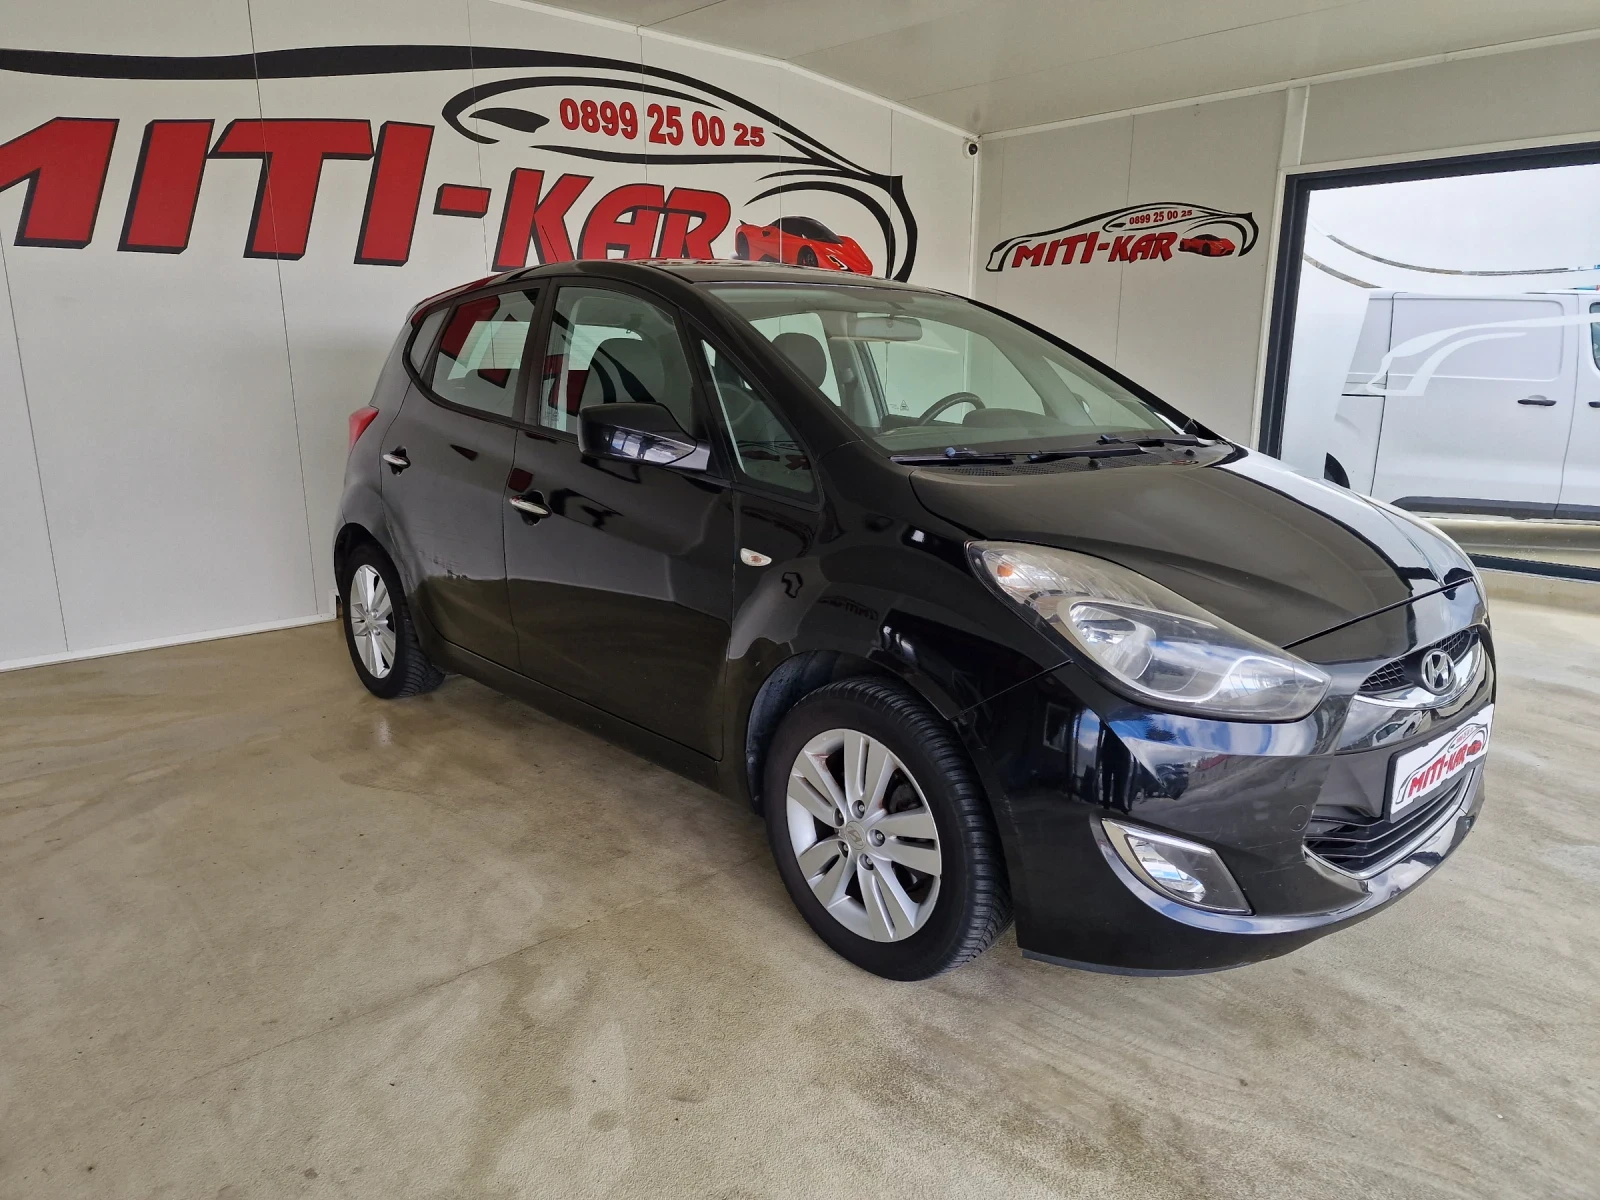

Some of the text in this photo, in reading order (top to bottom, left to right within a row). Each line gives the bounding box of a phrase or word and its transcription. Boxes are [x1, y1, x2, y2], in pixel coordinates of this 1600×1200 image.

[559, 98, 766, 147] 0899 25 00 25
[1129, 209, 1193, 225] 0899 25 00 25
[1011, 231, 1178, 268] MITI-KAR
[1408, 743, 1468, 798] MITI-KAR
